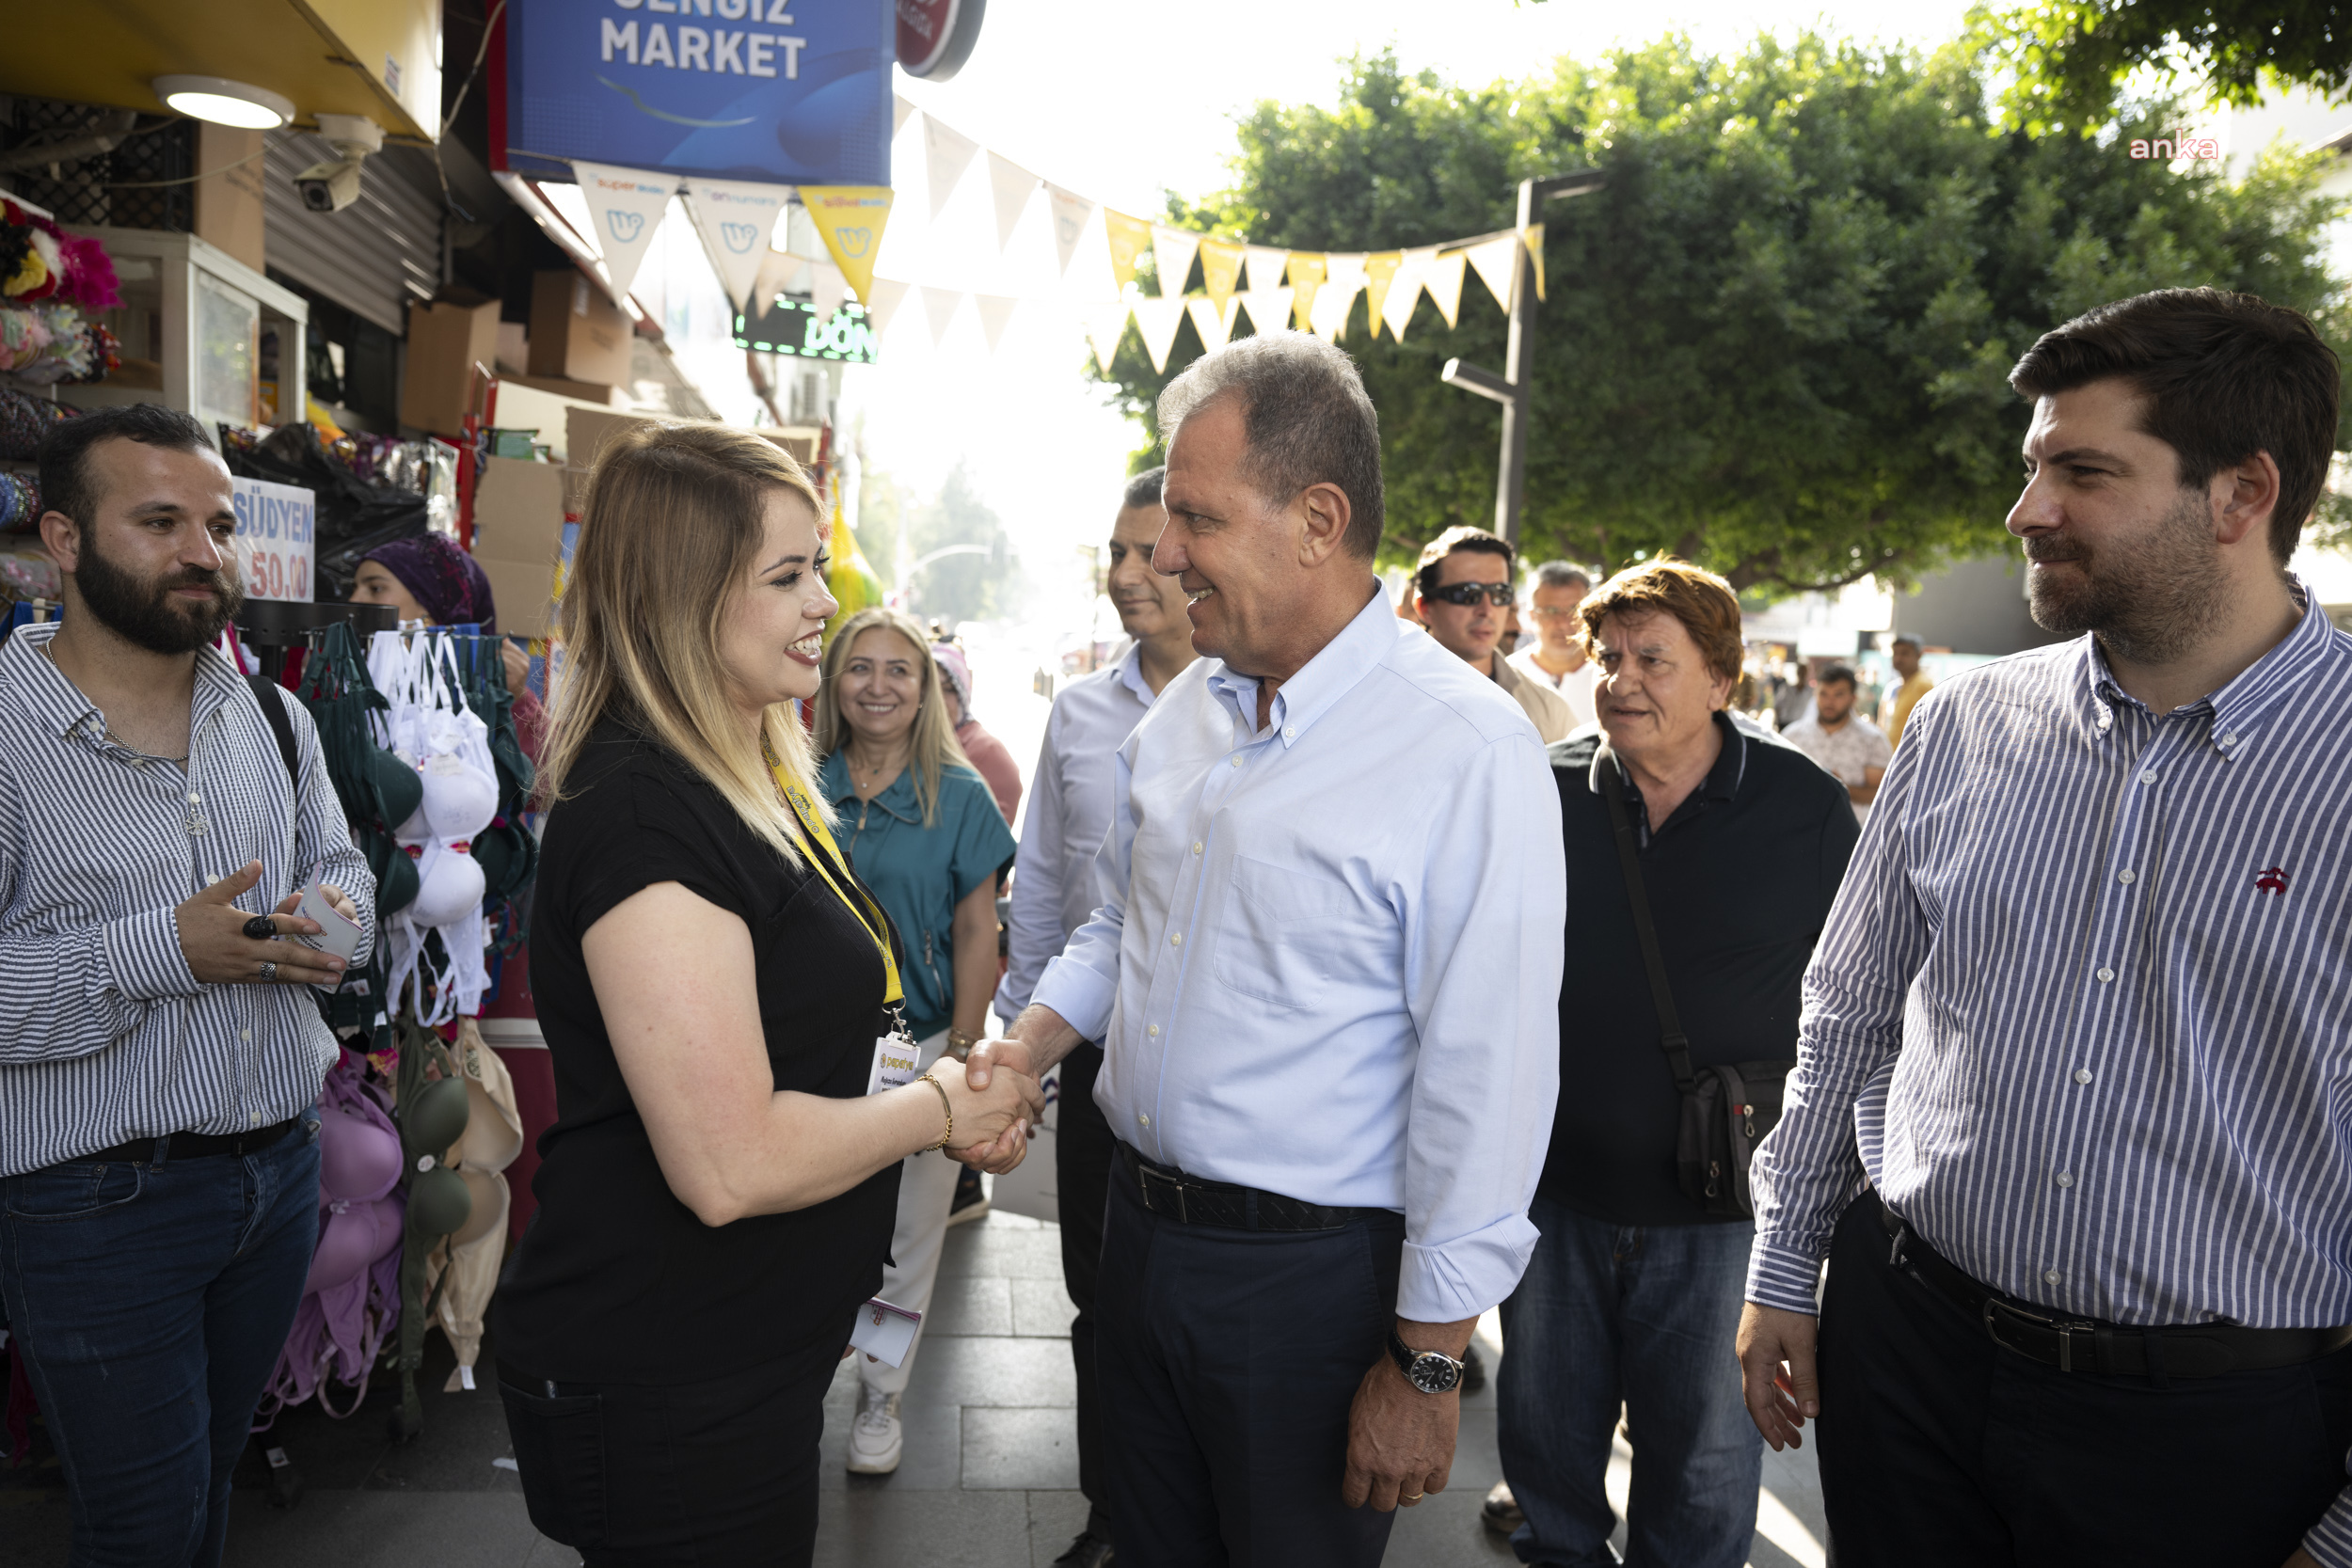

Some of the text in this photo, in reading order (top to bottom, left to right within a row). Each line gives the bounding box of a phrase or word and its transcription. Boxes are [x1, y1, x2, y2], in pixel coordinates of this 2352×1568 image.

[600, 17, 807, 80] MARKET
[233, 485, 313, 544] SÜDYEN
[787, 785, 817, 827] papatya
[886, 1056, 914, 1073] papatya
